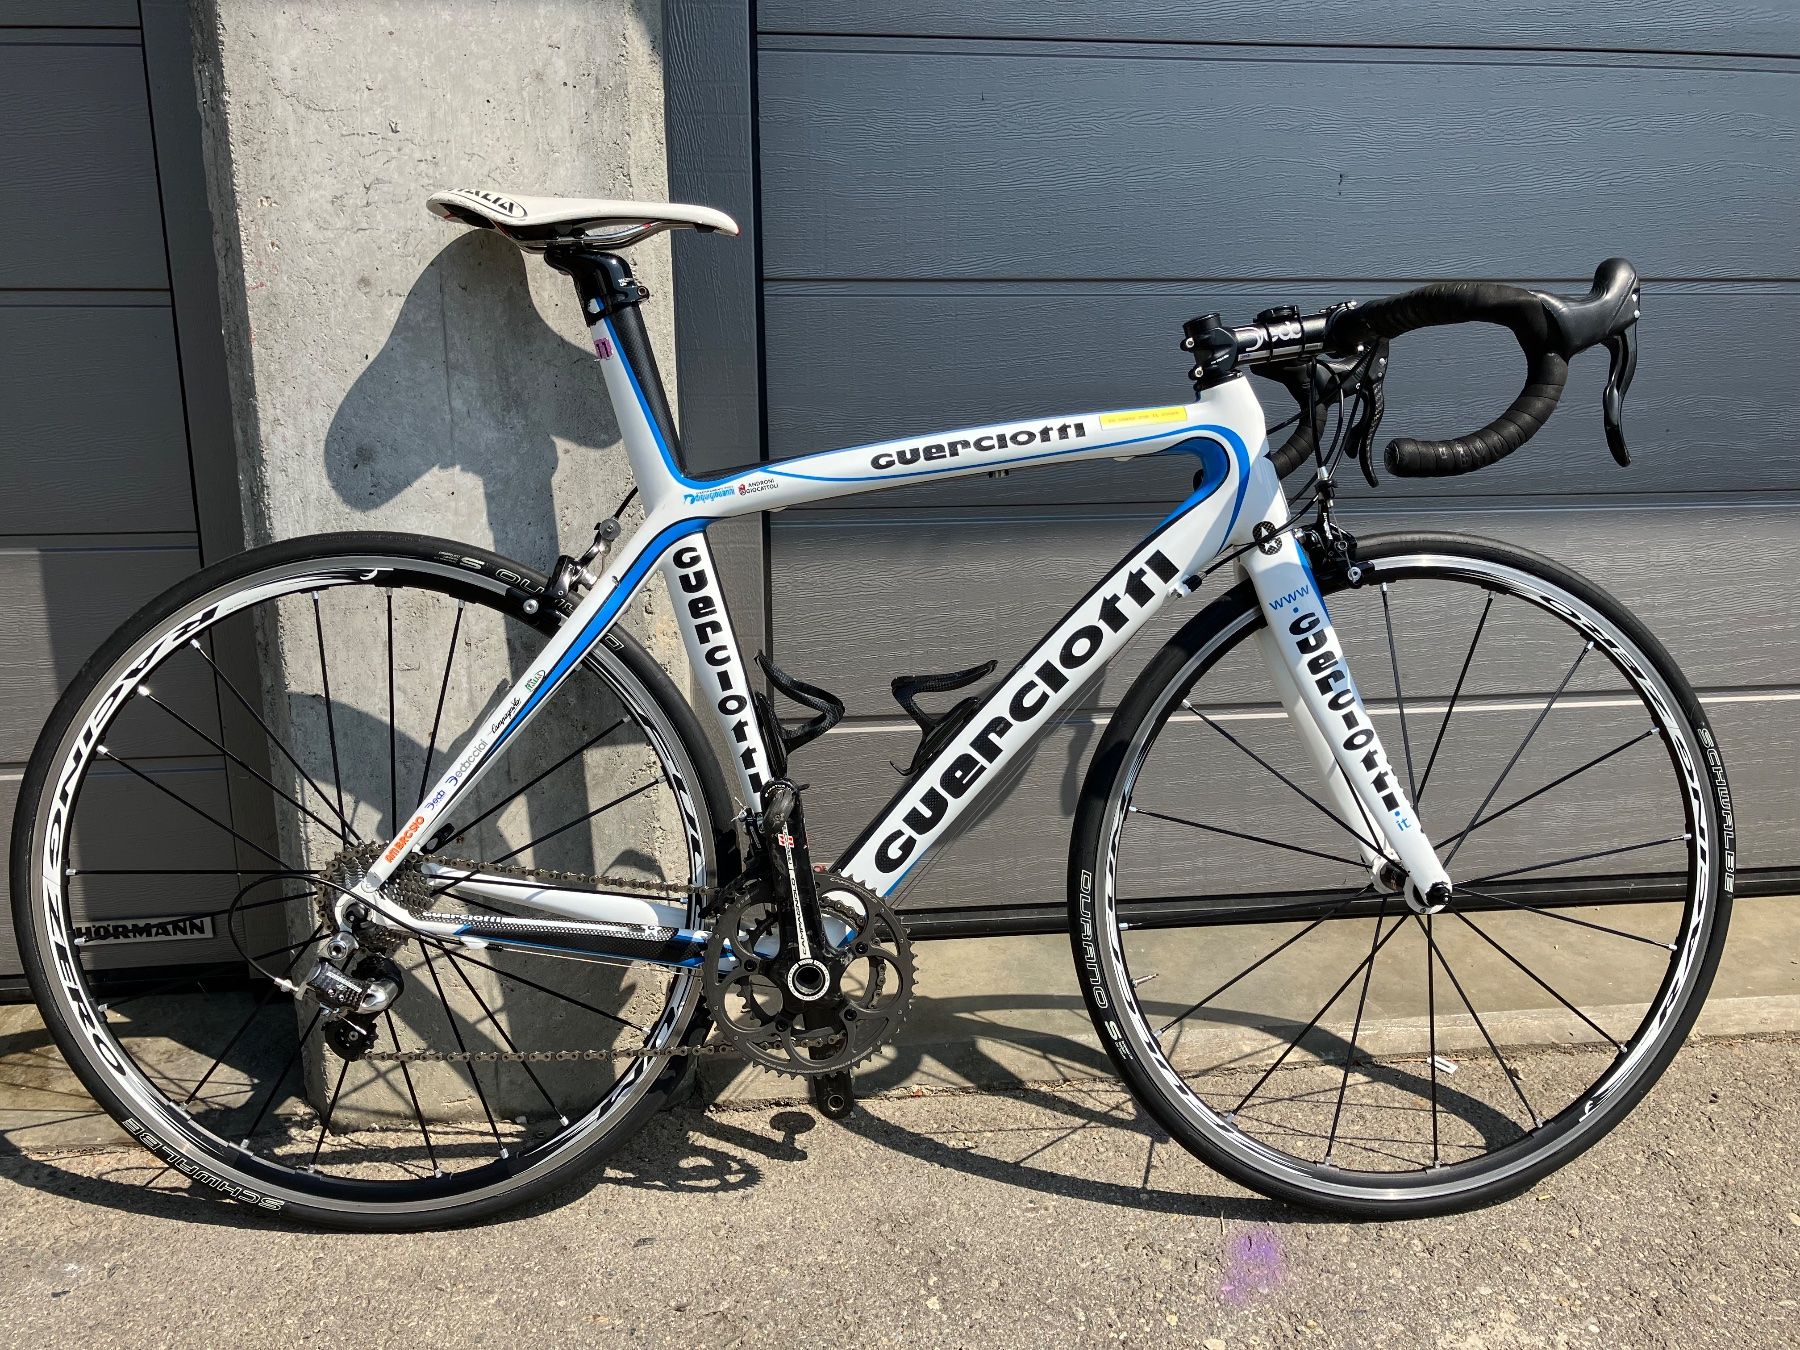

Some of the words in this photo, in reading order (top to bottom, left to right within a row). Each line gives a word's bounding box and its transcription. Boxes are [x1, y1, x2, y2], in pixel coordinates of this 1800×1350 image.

[1699, 730, 1734, 894] SCHWALBE
[1079, 869, 1109, 1009] DURANO
[122, 1117, 285, 1212] SCHWALBE
